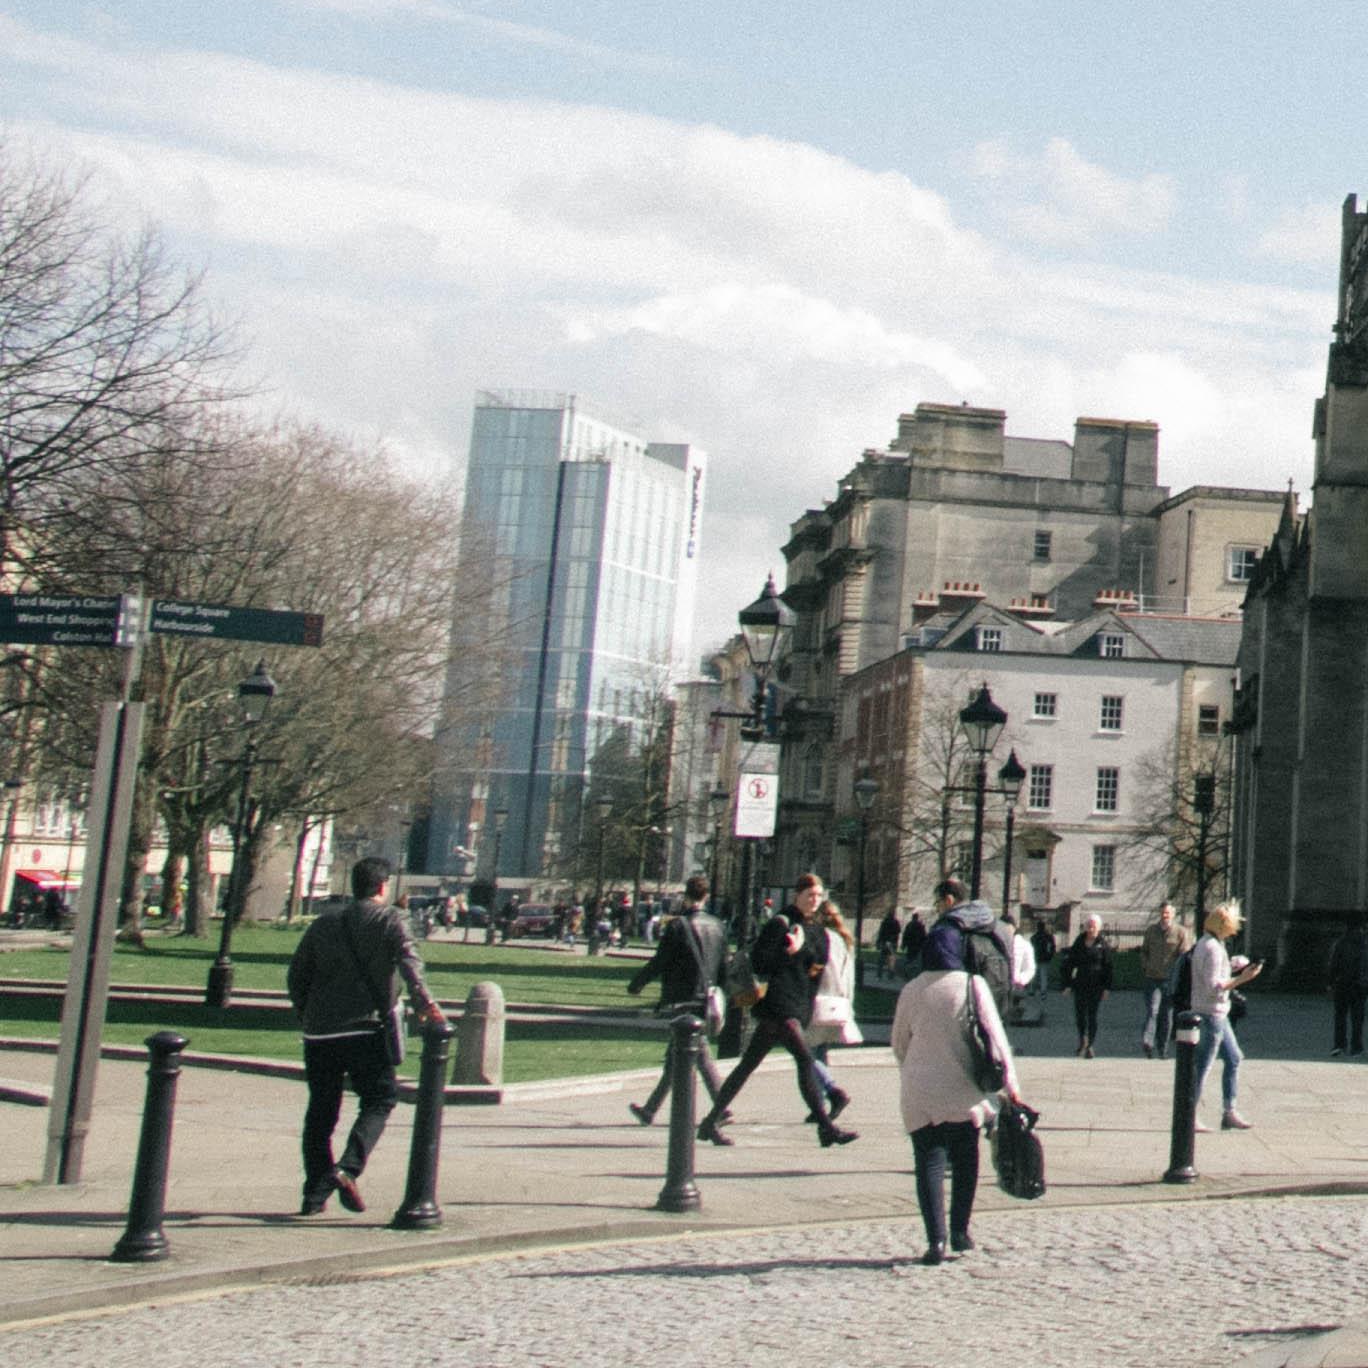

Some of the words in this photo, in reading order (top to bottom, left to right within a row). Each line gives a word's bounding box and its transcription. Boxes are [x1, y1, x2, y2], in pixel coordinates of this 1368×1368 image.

[13, 597, 37, 607] Lord
[39, 597, 80, 609] Mayor's
[156, 602, 194, 616] College
[196, 605, 230, 618] Square
[18, 613, 45, 624] West
[47, 614, 67, 624] End
